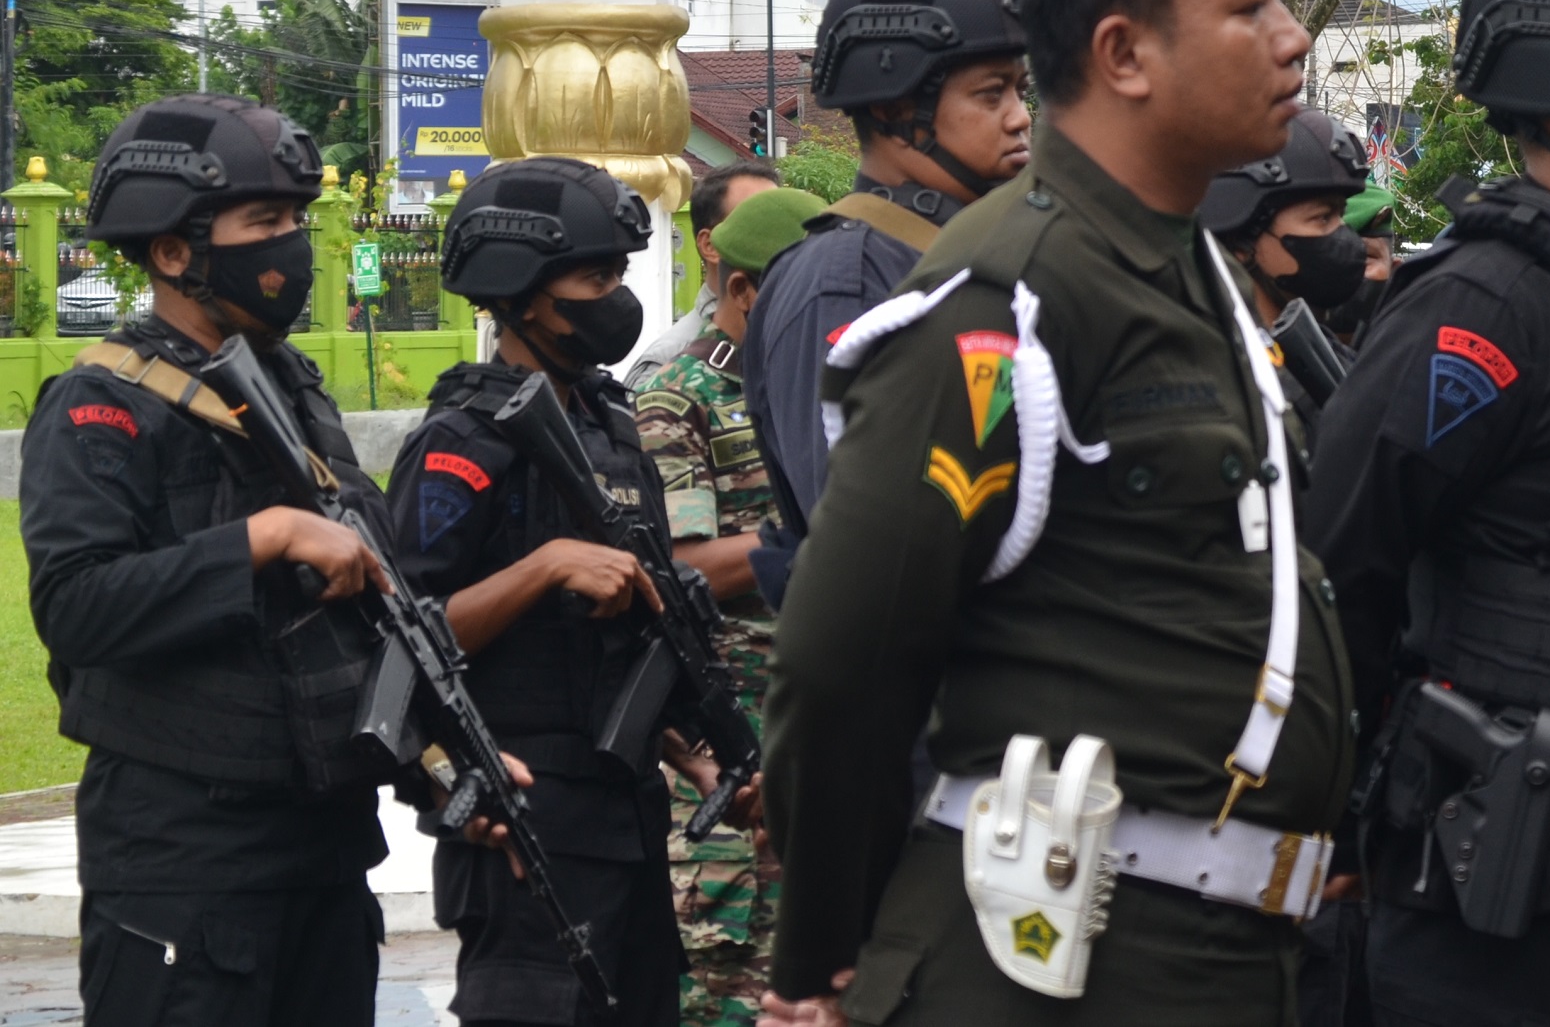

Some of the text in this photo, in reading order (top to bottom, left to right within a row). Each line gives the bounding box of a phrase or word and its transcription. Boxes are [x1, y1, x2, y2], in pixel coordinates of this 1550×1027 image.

[397, 21, 422, 31] NEW
[402, 54, 479, 69] INTENSE
[402, 93, 445, 108] MILD
[1442, 331, 1512, 383] PELOPOR
[432, 458, 483, 486] PELOPOR
